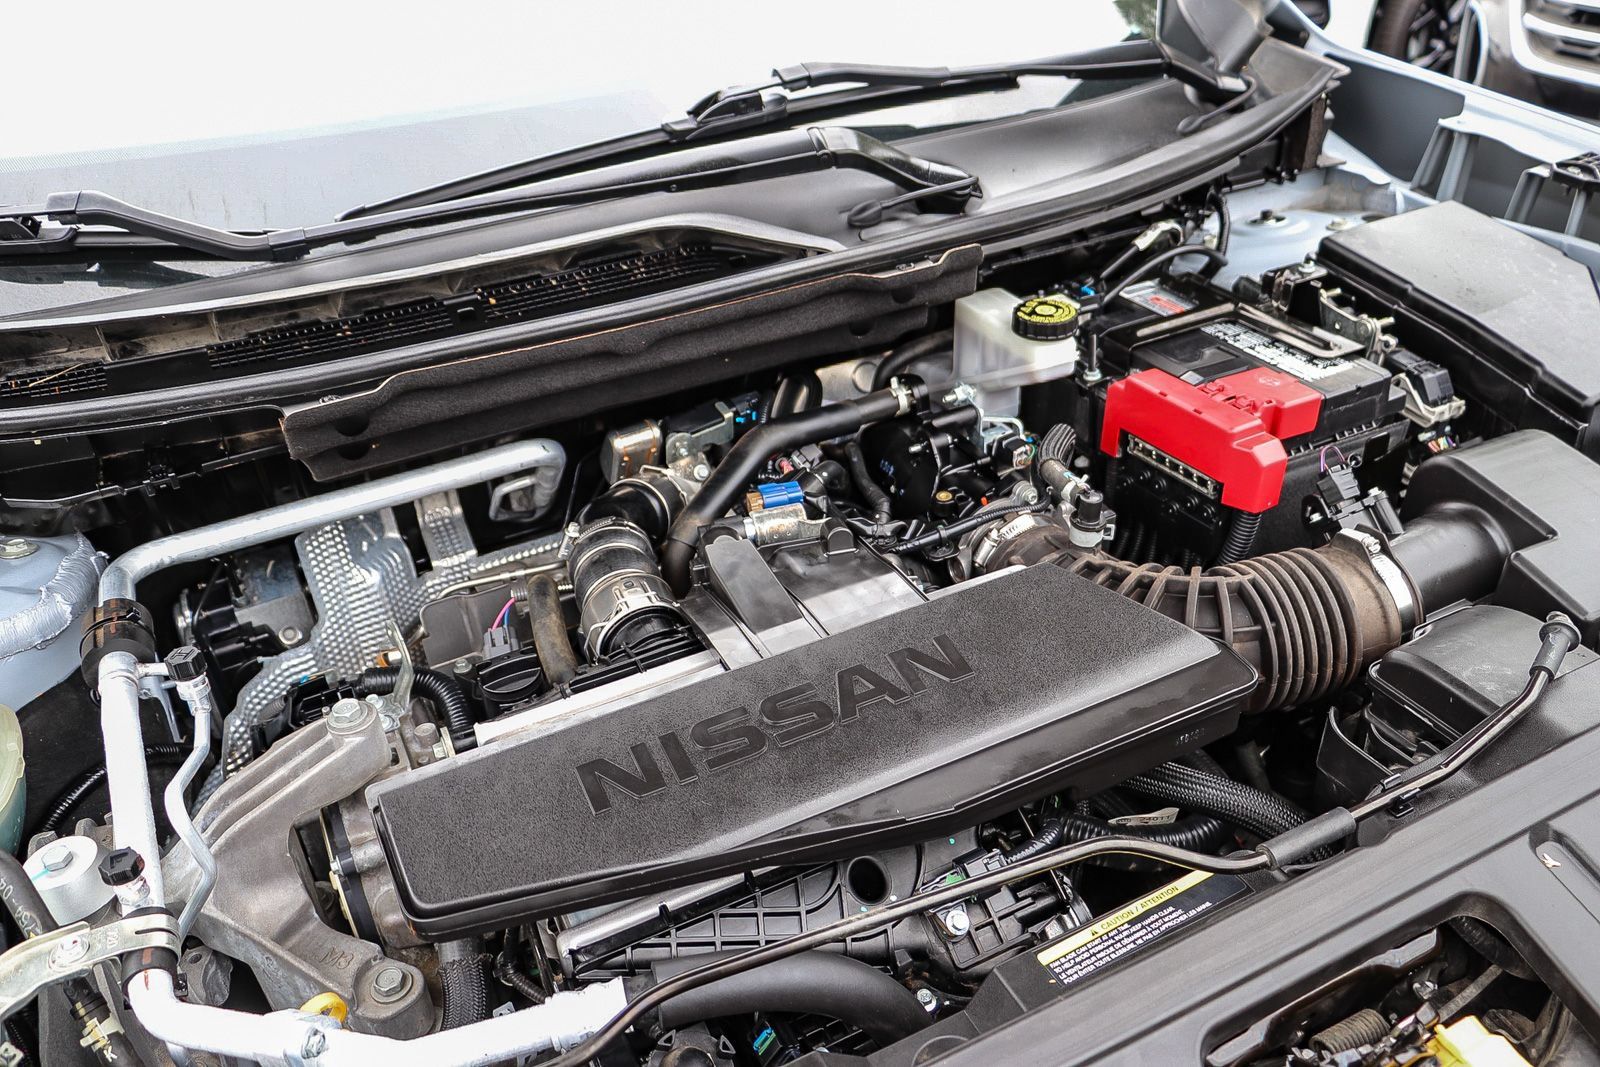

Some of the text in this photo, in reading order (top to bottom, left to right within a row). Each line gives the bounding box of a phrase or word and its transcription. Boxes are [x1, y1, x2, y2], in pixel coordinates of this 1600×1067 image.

[576, 633, 976, 816] NISSAN
[1101, 910, 1134, 930] CAUTION
[1140, 886, 1179, 909] ATTENTION
[1060, 952, 1077, 963] BLADE
[1087, 938, 1102, 948] START
[1061, 960, 1076, 970] HELP
[1074, 952, 1091, 963] AVOID
[1089, 939, 1115, 954] PERSONAL
[1142, 915, 1160, 926] HANDS
[1064, 974, 1079, 984] POUR
[1095, 957, 1111, 967] TOUTE
[1160, 915, 1188, 932] APPROCHER
[1065, 957, 1097, 976] VENTILATEUR
[1096, 947, 1115, 959] RISQUE
[1150, 920, 1164, 930] TOUT
